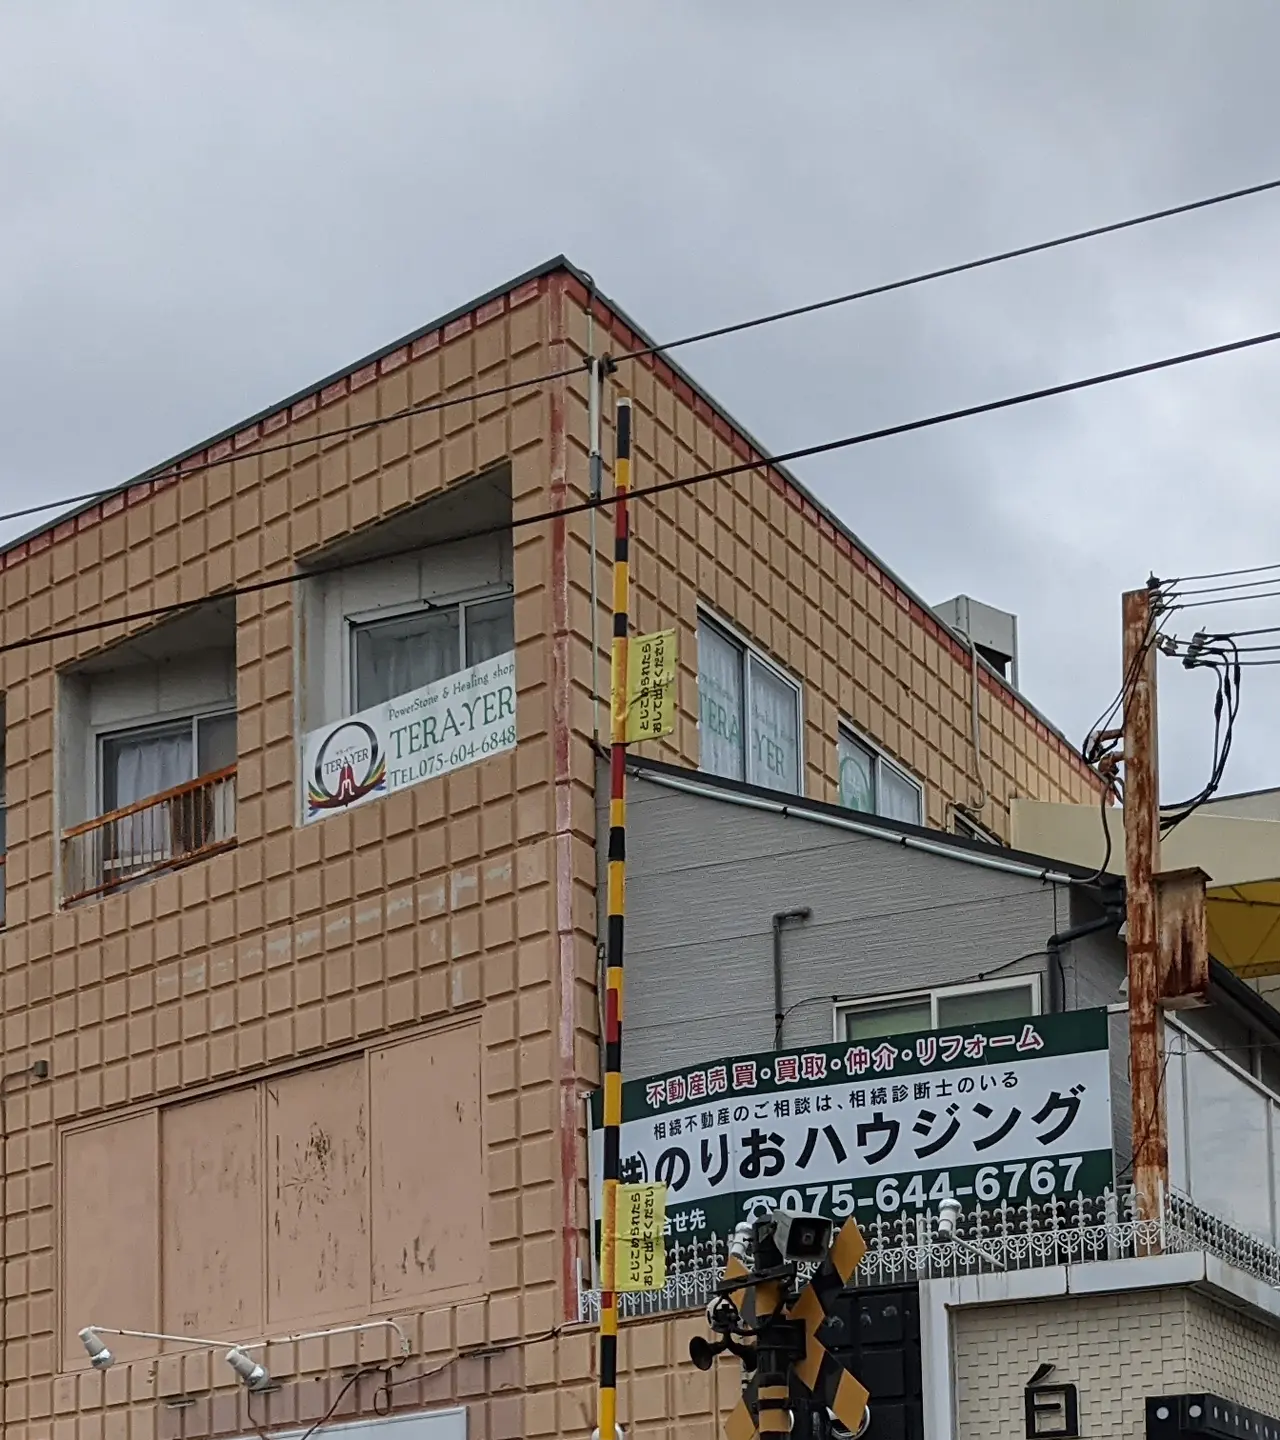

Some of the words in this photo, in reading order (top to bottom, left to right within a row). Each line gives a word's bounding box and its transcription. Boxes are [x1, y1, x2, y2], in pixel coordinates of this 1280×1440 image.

[443, 687, 450, 699] &
[453, 672, 489, 693] Healing
[492, 662, 515, 683] shop
[390, 686, 516, 759] TERA-YER
[779, 1156, 1083, 1218] 075-644-6767
